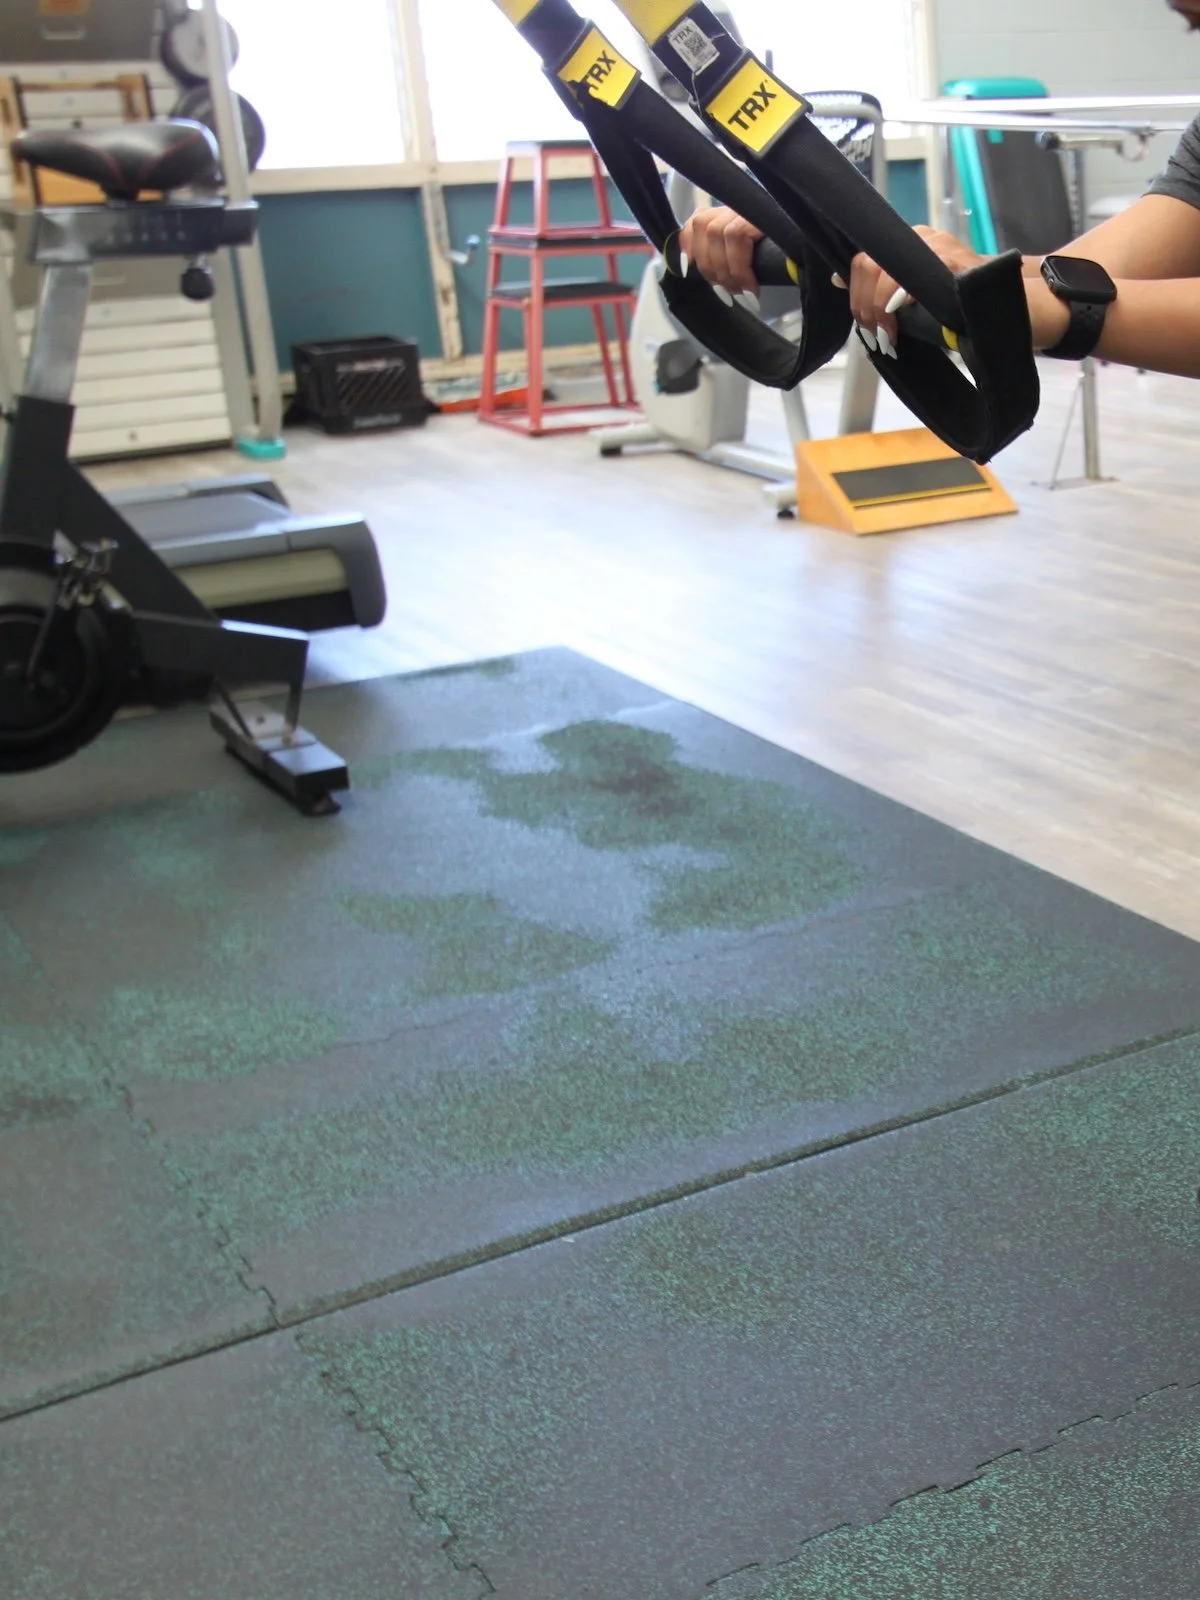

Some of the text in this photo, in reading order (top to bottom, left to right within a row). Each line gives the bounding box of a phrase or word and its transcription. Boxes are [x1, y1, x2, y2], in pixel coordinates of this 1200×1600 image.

[672, 26, 693, 44] TRX
[579, 50, 616, 90] TRX
[727, 81, 777, 131] TRX
